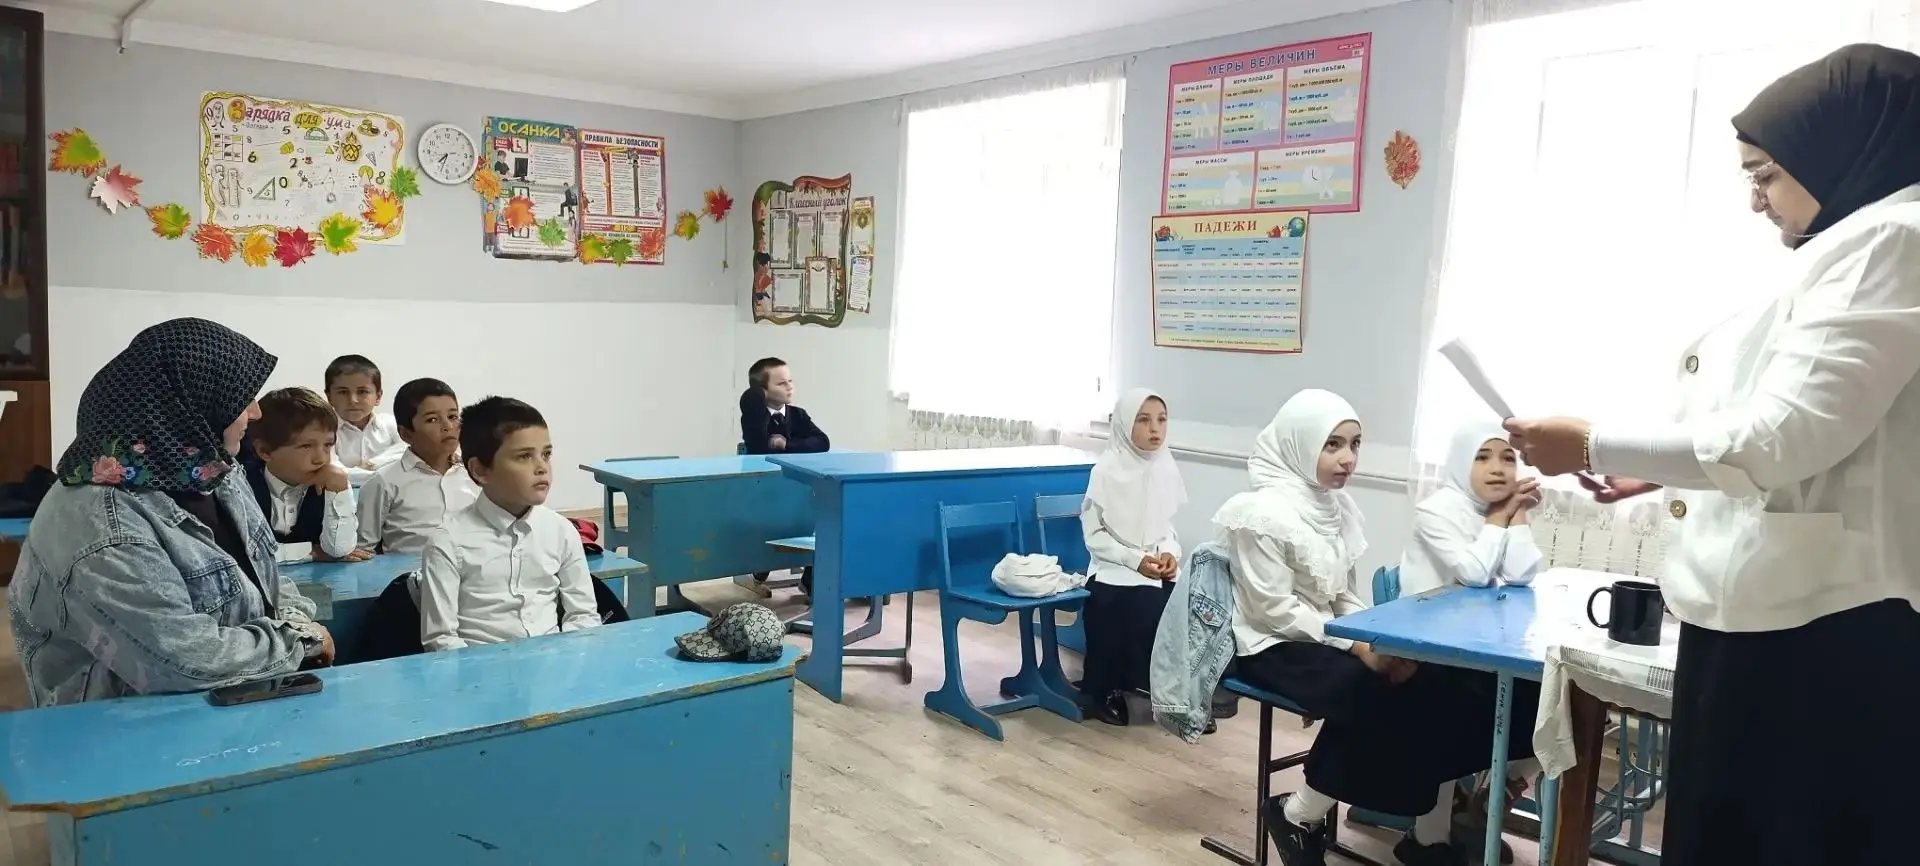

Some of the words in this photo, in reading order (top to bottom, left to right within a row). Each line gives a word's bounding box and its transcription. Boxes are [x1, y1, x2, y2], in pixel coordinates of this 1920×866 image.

[1207, 60, 1244, 76] МЕРЫ
[1250, 49, 1316, 70] ВЕЛИЧИН
[229, 100, 291, 124] Зарядка
[295, 112, 319, 125] для
[283, 126, 291, 135] 5
[498, 121, 561, 138] ОСАНКА
[584, 134, 613, 144] ПРАВИЛА
[616, 136, 660, 149] БЕЗОПАСНОСТИ
[248, 151, 258, 163] 6
[290, 158, 298, 169] 2
[279, 176, 288, 188] 0
[1194, 220, 1258, 235] ПАДЕЖИ
